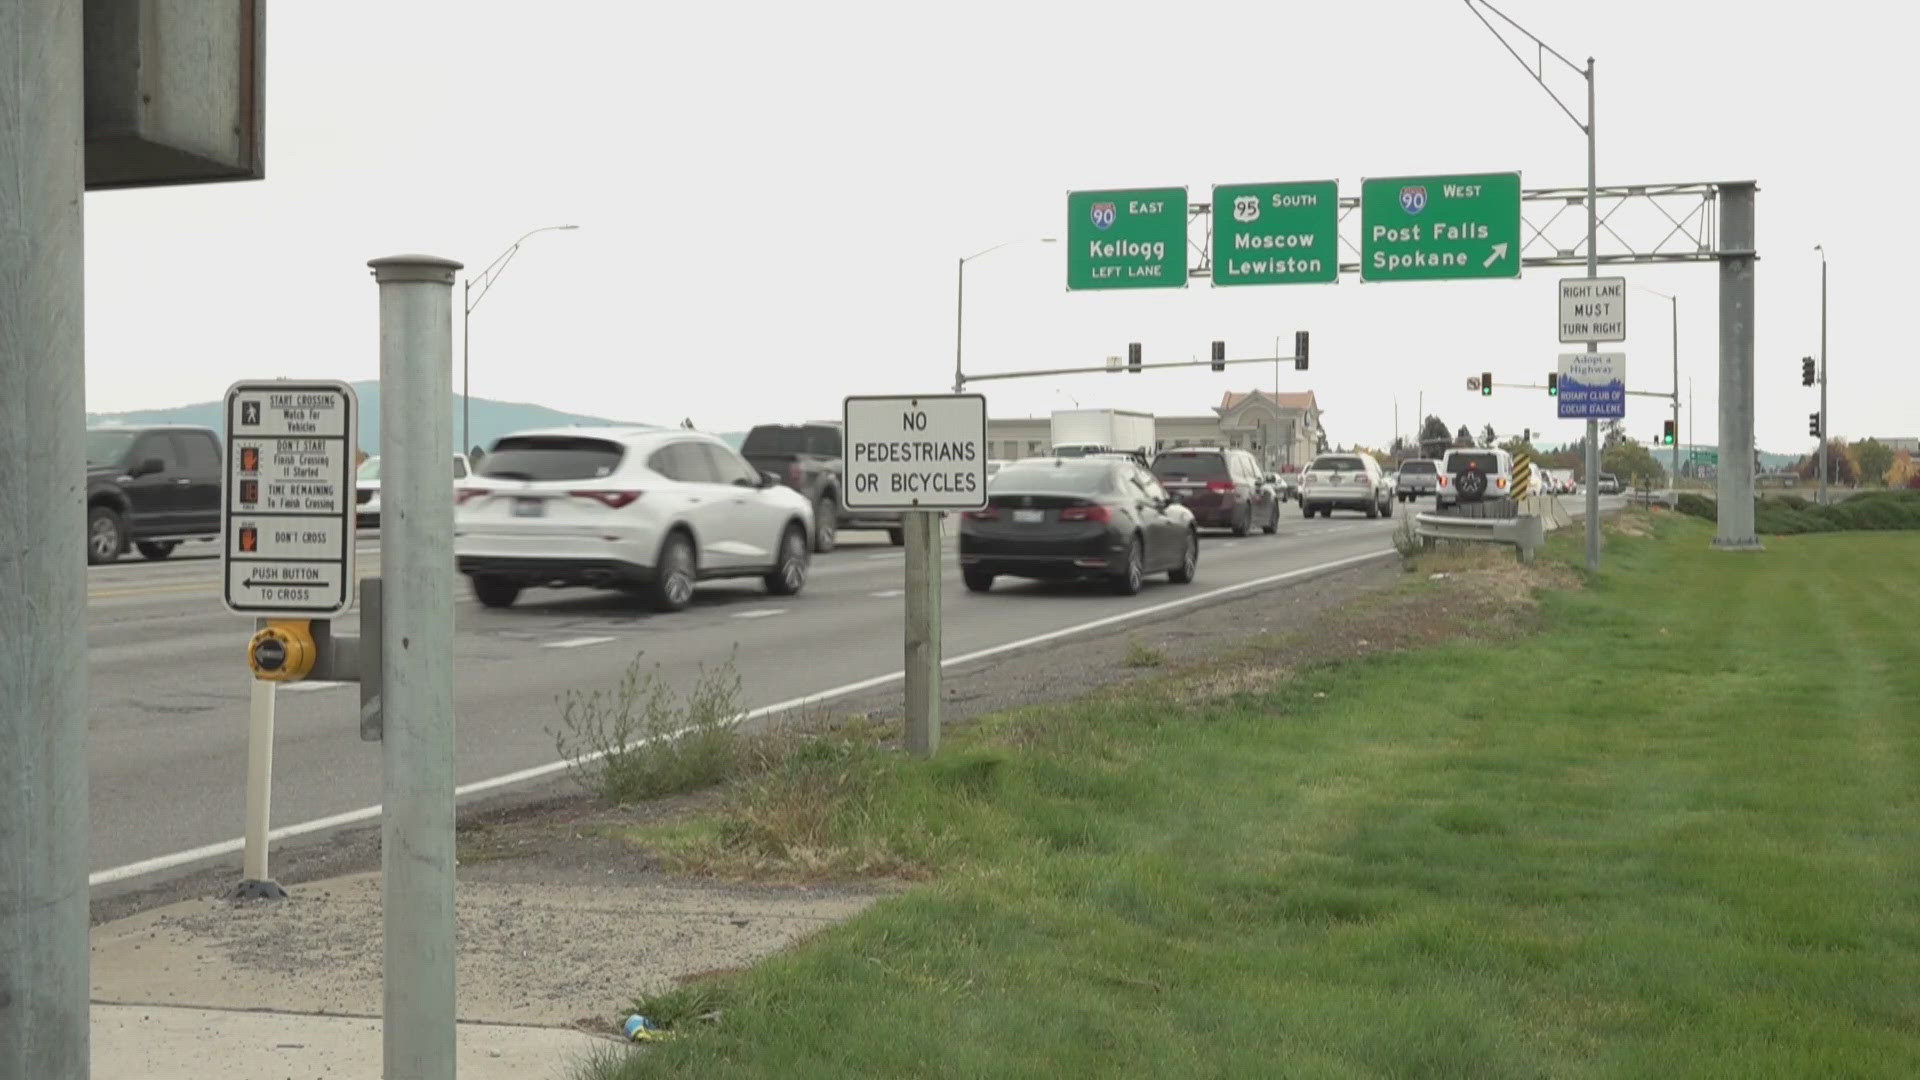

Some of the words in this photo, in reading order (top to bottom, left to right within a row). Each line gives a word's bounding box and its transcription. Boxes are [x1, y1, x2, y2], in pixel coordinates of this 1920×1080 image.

[1402, 193, 1424, 209] 90
[1443, 184, 1482, 198] WEST
[1236, 201, 1257, 216] 95
[1272, 194, 1317, 207] SOUTH
[1093, 209, 1114, 225] 90
[1129, 201, 1164, 215] EAST
[1373, 224, 1420, 242] Post
[1434, 222, 1488, 240] Falls
[1235, 233, 1314, 249] Moscow
[1090, 240, 1165, 260] Kellogg
[1229, 257, 1321, 275] Lewiston
[1373, 250, 1468, 270] Spokane
[1092, 266, 1121, 278] LEFT
[1128, 265, 1161, 277] LANE
[1563, 286, 1591, 298] RIGHT
[1595, 285, 1621, 297] LANE
[1574, 304, 1610, 317] MUST
[1563, 323, 1588, 335] TURN
[1592, 322, 1622, 334] RIGHT
[1573, 355, 1602, 365] Adopt
[1570, 365, 1613, 375] Highway
[269, 394, 292, 405] START
[296, 394, 336, 405] CROSSING
[1560, 391, 1588, 401] ROTARY
[1589, 391, 1610, 401] CLUB
[1611, 391, 1622, 400] OF
[283, 408, 304, 420] Watch
[1560, 403, 1587, 415] COEUR
[287, 421, 316, 433] Vehicles
[903, 411, 927, 431] NO
[303, 439, 326, 451] START
[855, 441, 976, 462] PEDESTRIANS
[274, 453, 295, 466] Finish
[299, 453, 329, 468] Crossing
[293, 467, 319, 477] Started
[855, 473, 879, 492] OR
[891, 472, 976, 492] BICYCLES
[268, 484, 285, 496] TIME
[290, 484, 334, 497] REMAINING
[305, 498, 334, 511] Crossing
[275, 532, 299, 544] DON'T
[302, 532, 327, 544] CROSS
[252, 568, 278, 580] PUSH
[282, 568, 319, 580] BUTTON
[261, 589, 275, 600] TO
[277, 589, 310, 600] CROSS
